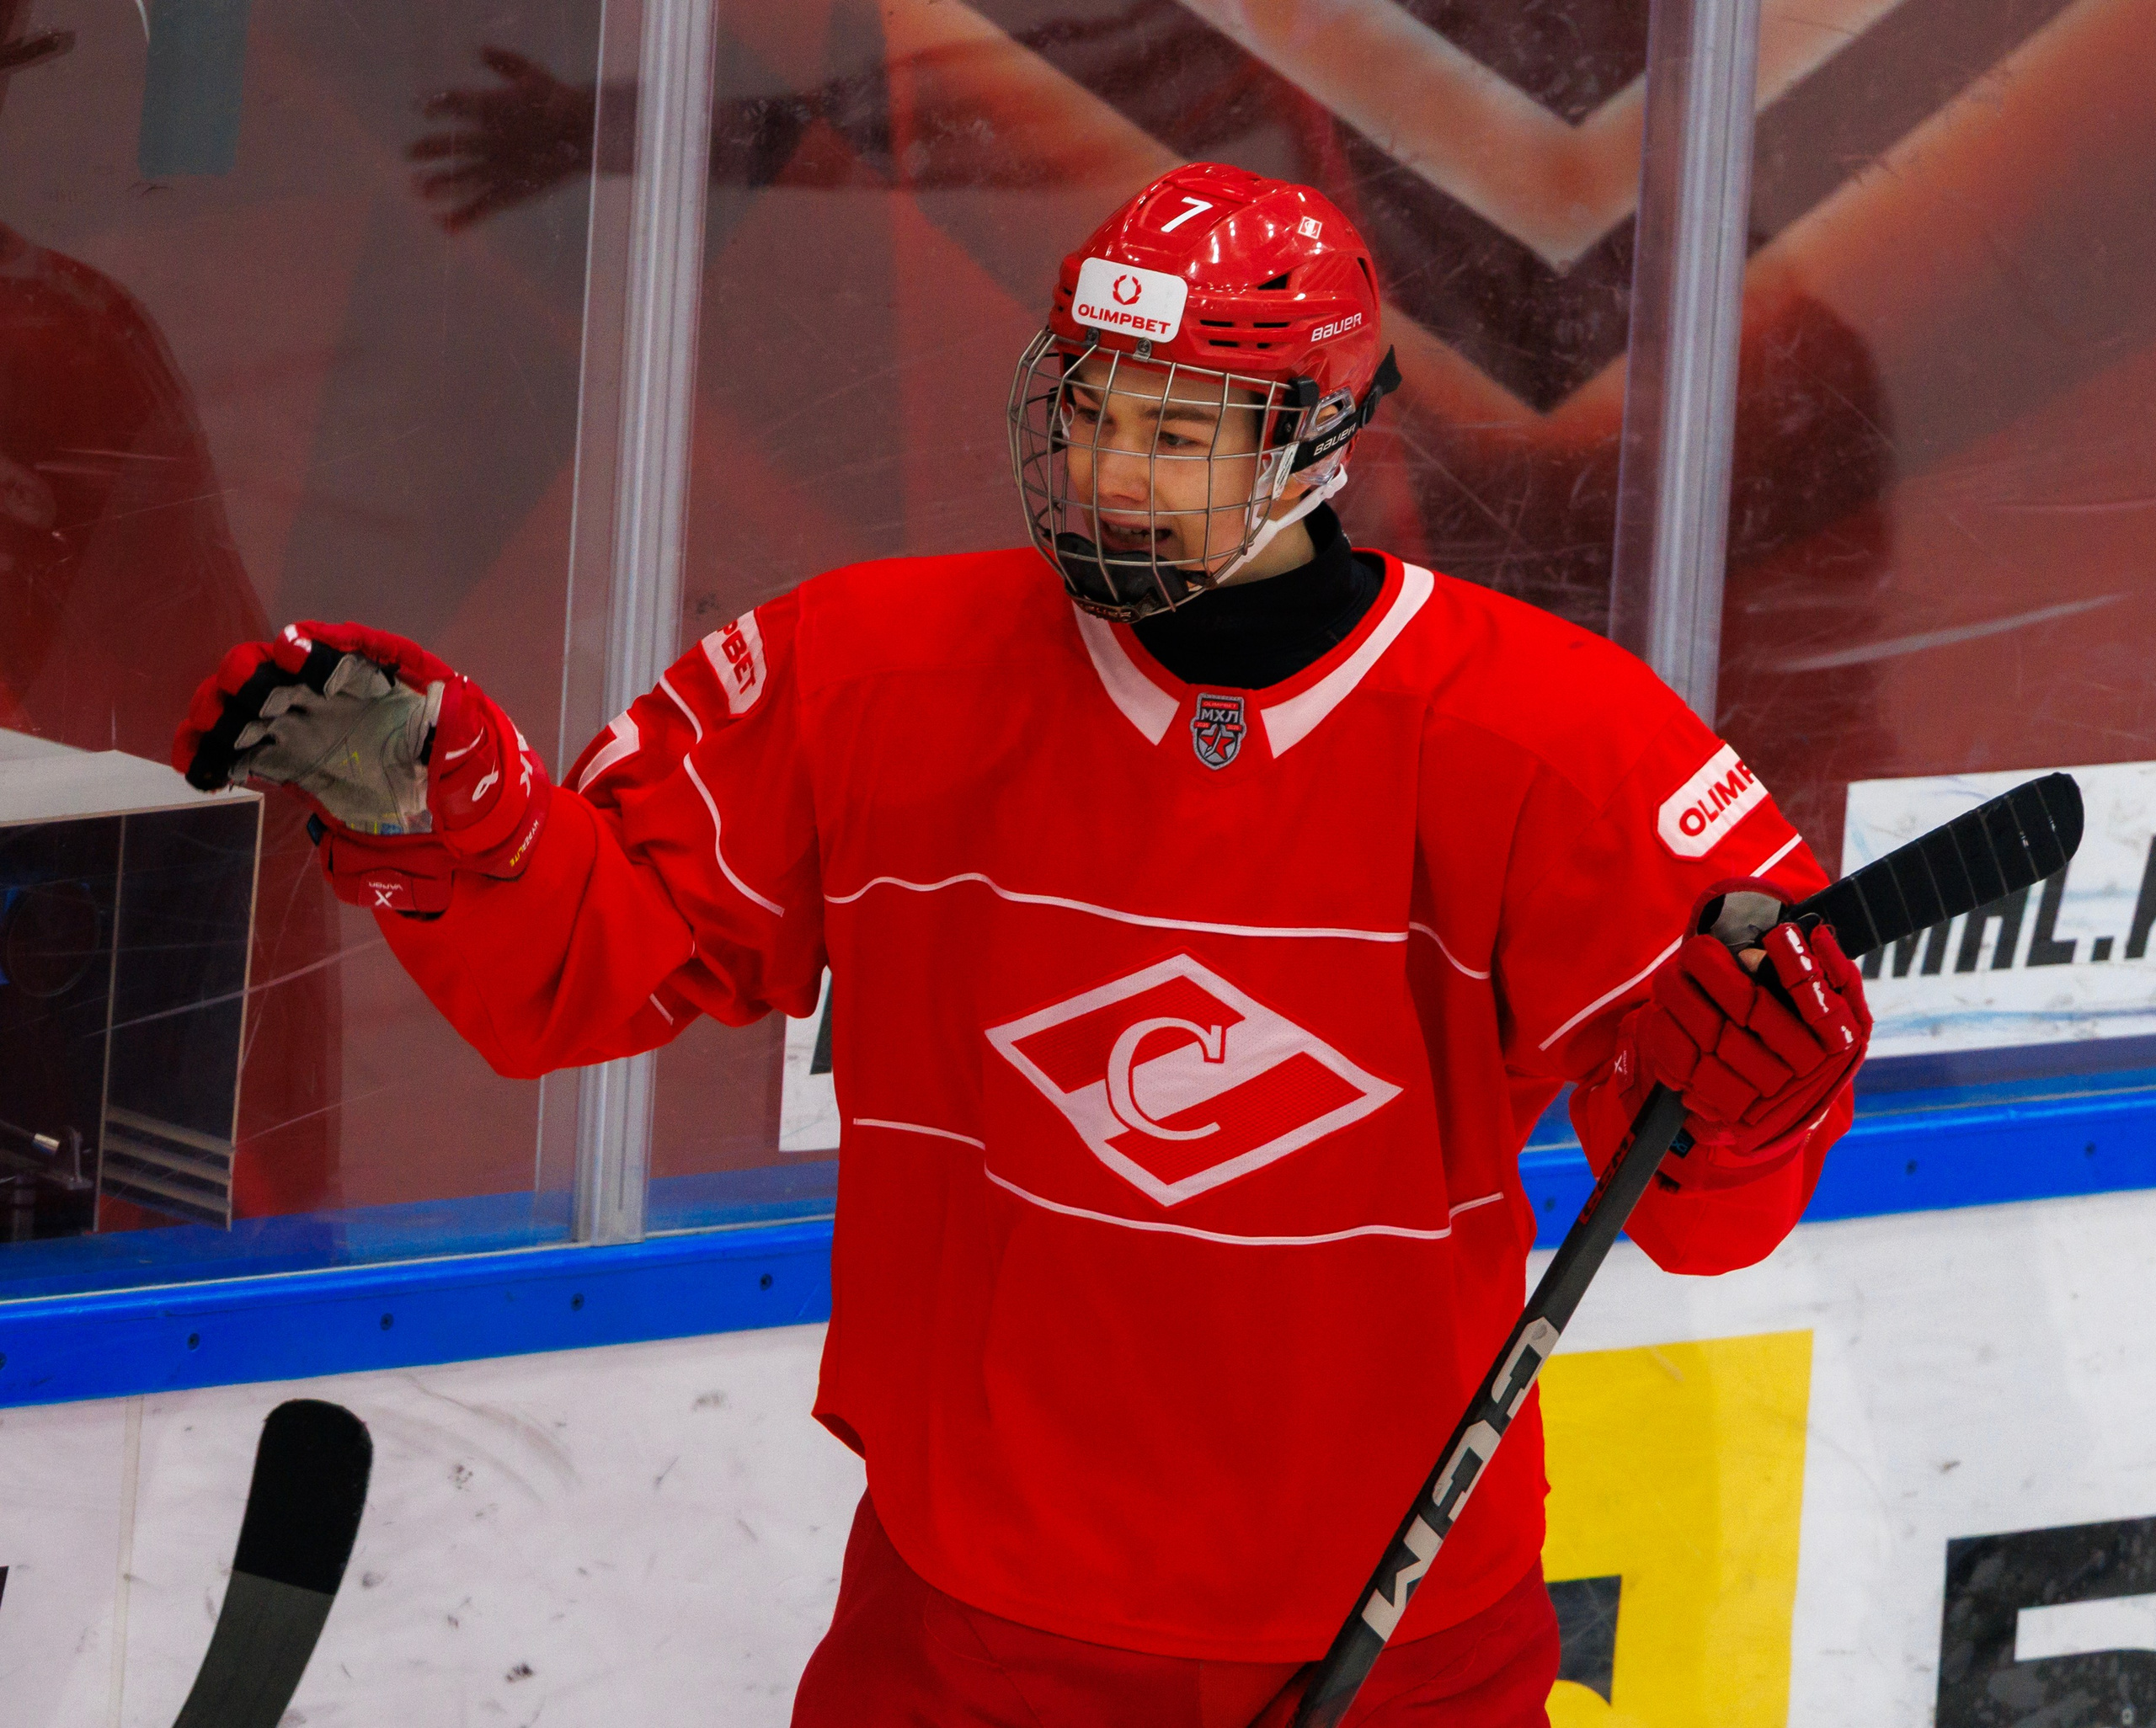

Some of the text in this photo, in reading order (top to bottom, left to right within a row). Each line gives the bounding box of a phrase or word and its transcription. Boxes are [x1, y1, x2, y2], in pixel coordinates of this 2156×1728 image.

[1161, 196, 1213, 233] 7
[1078, 304, 1171, 334] OLIMPBET
[1310, 312, 1362, 342] BAUER
[1313, 422, 1357, 456] BAUER
[1201, 708, 1240, 723] МХЛ
[510, 819, 539, 867] HYPERLITE
[1861, 834, 2156, 979] HL.
